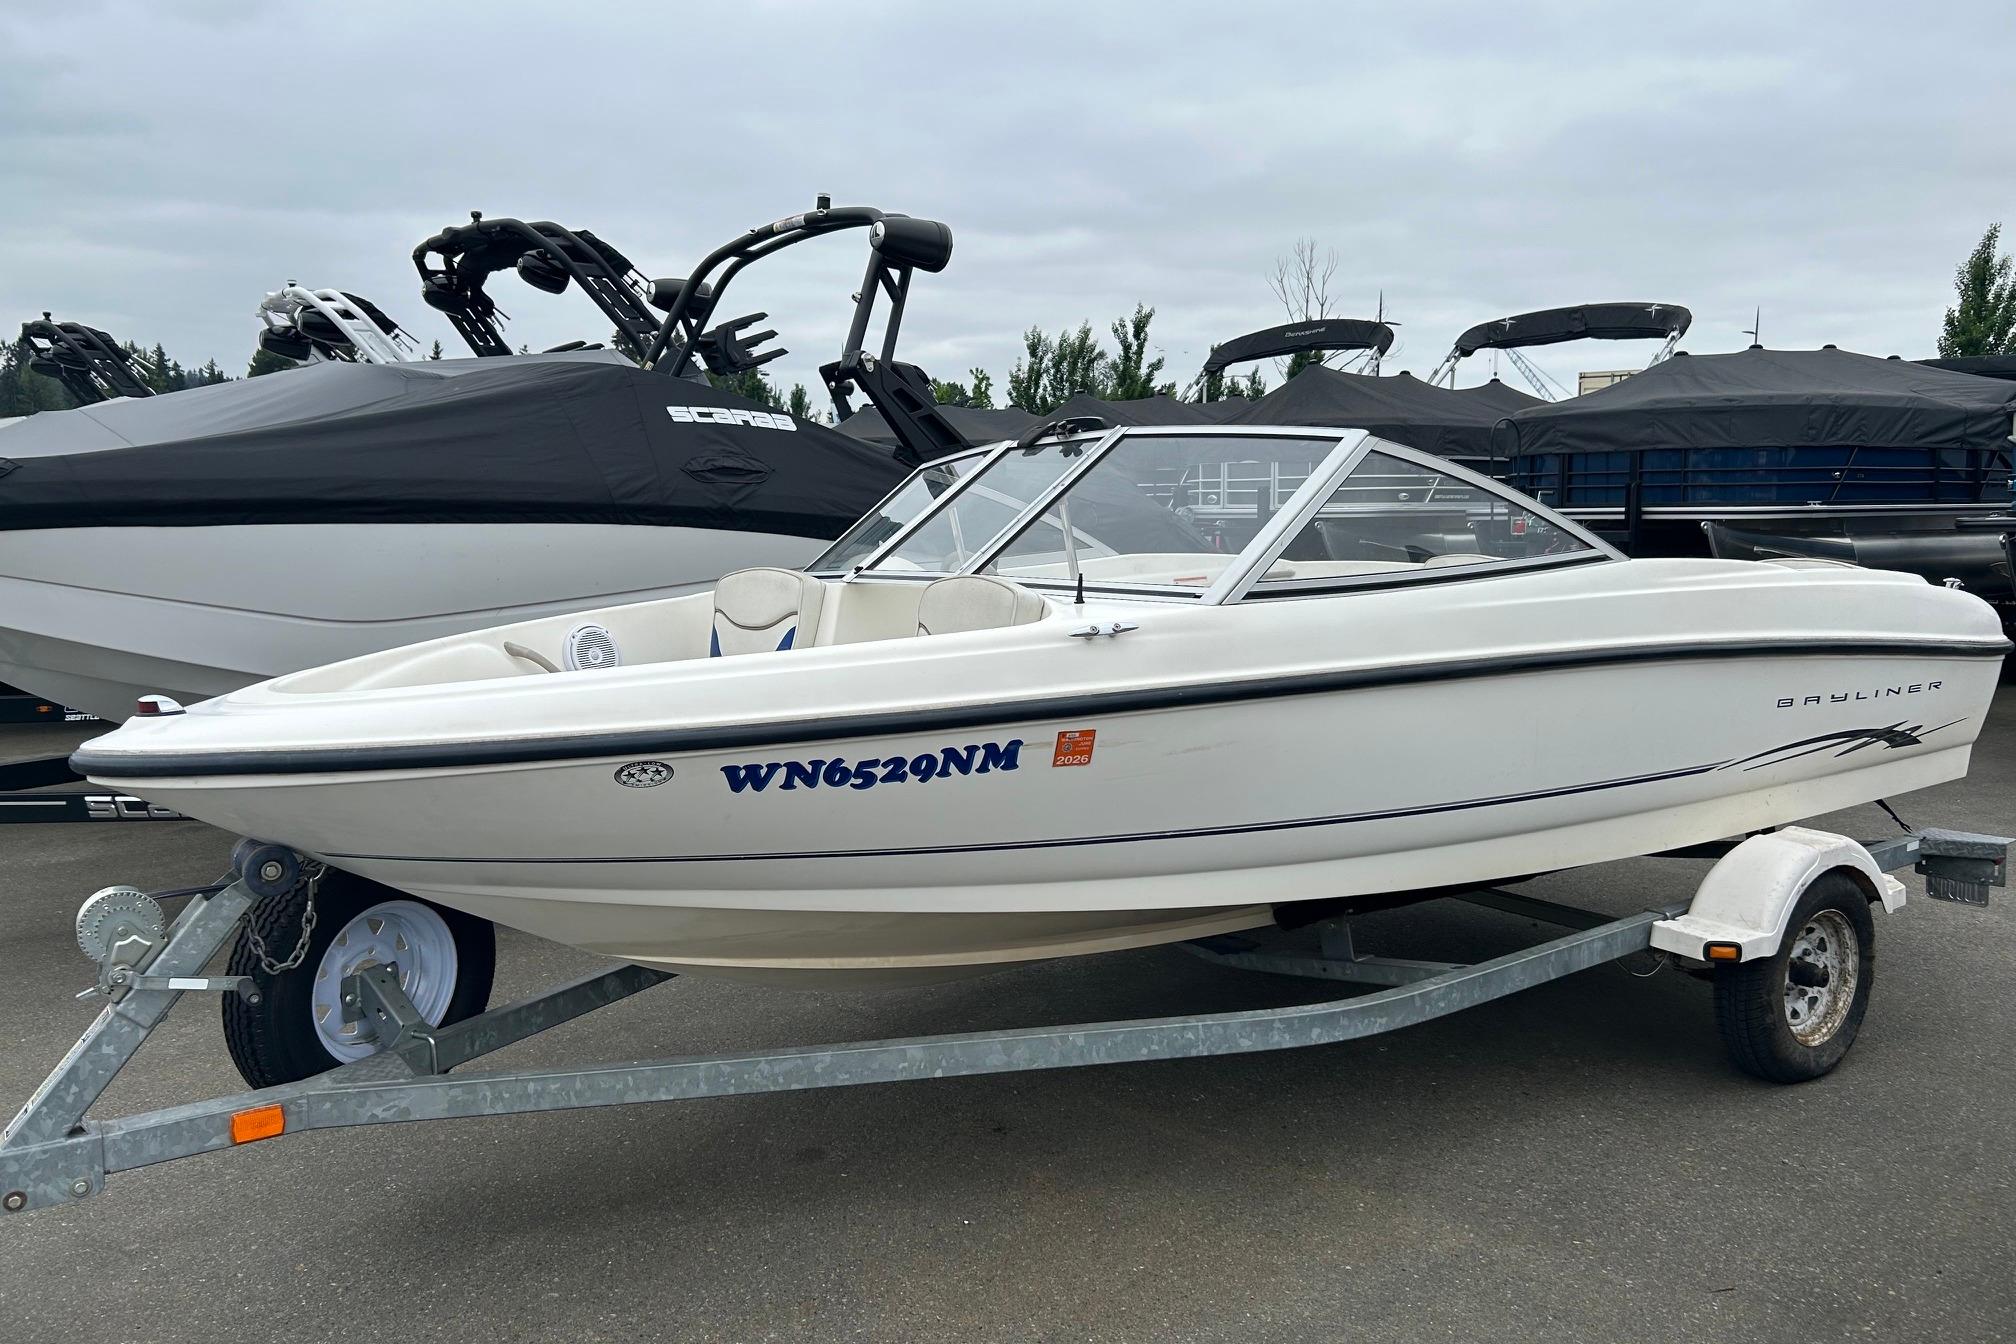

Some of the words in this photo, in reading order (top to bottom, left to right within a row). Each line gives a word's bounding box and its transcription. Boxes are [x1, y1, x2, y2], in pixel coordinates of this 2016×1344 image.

[666, 406, 798, 432] SCARAB
[1777, 681, 1942, 708] BAYLINER
[719, 739, 1025, 793] WN6529NM
[1056, 754, 1089, 765] 2026
